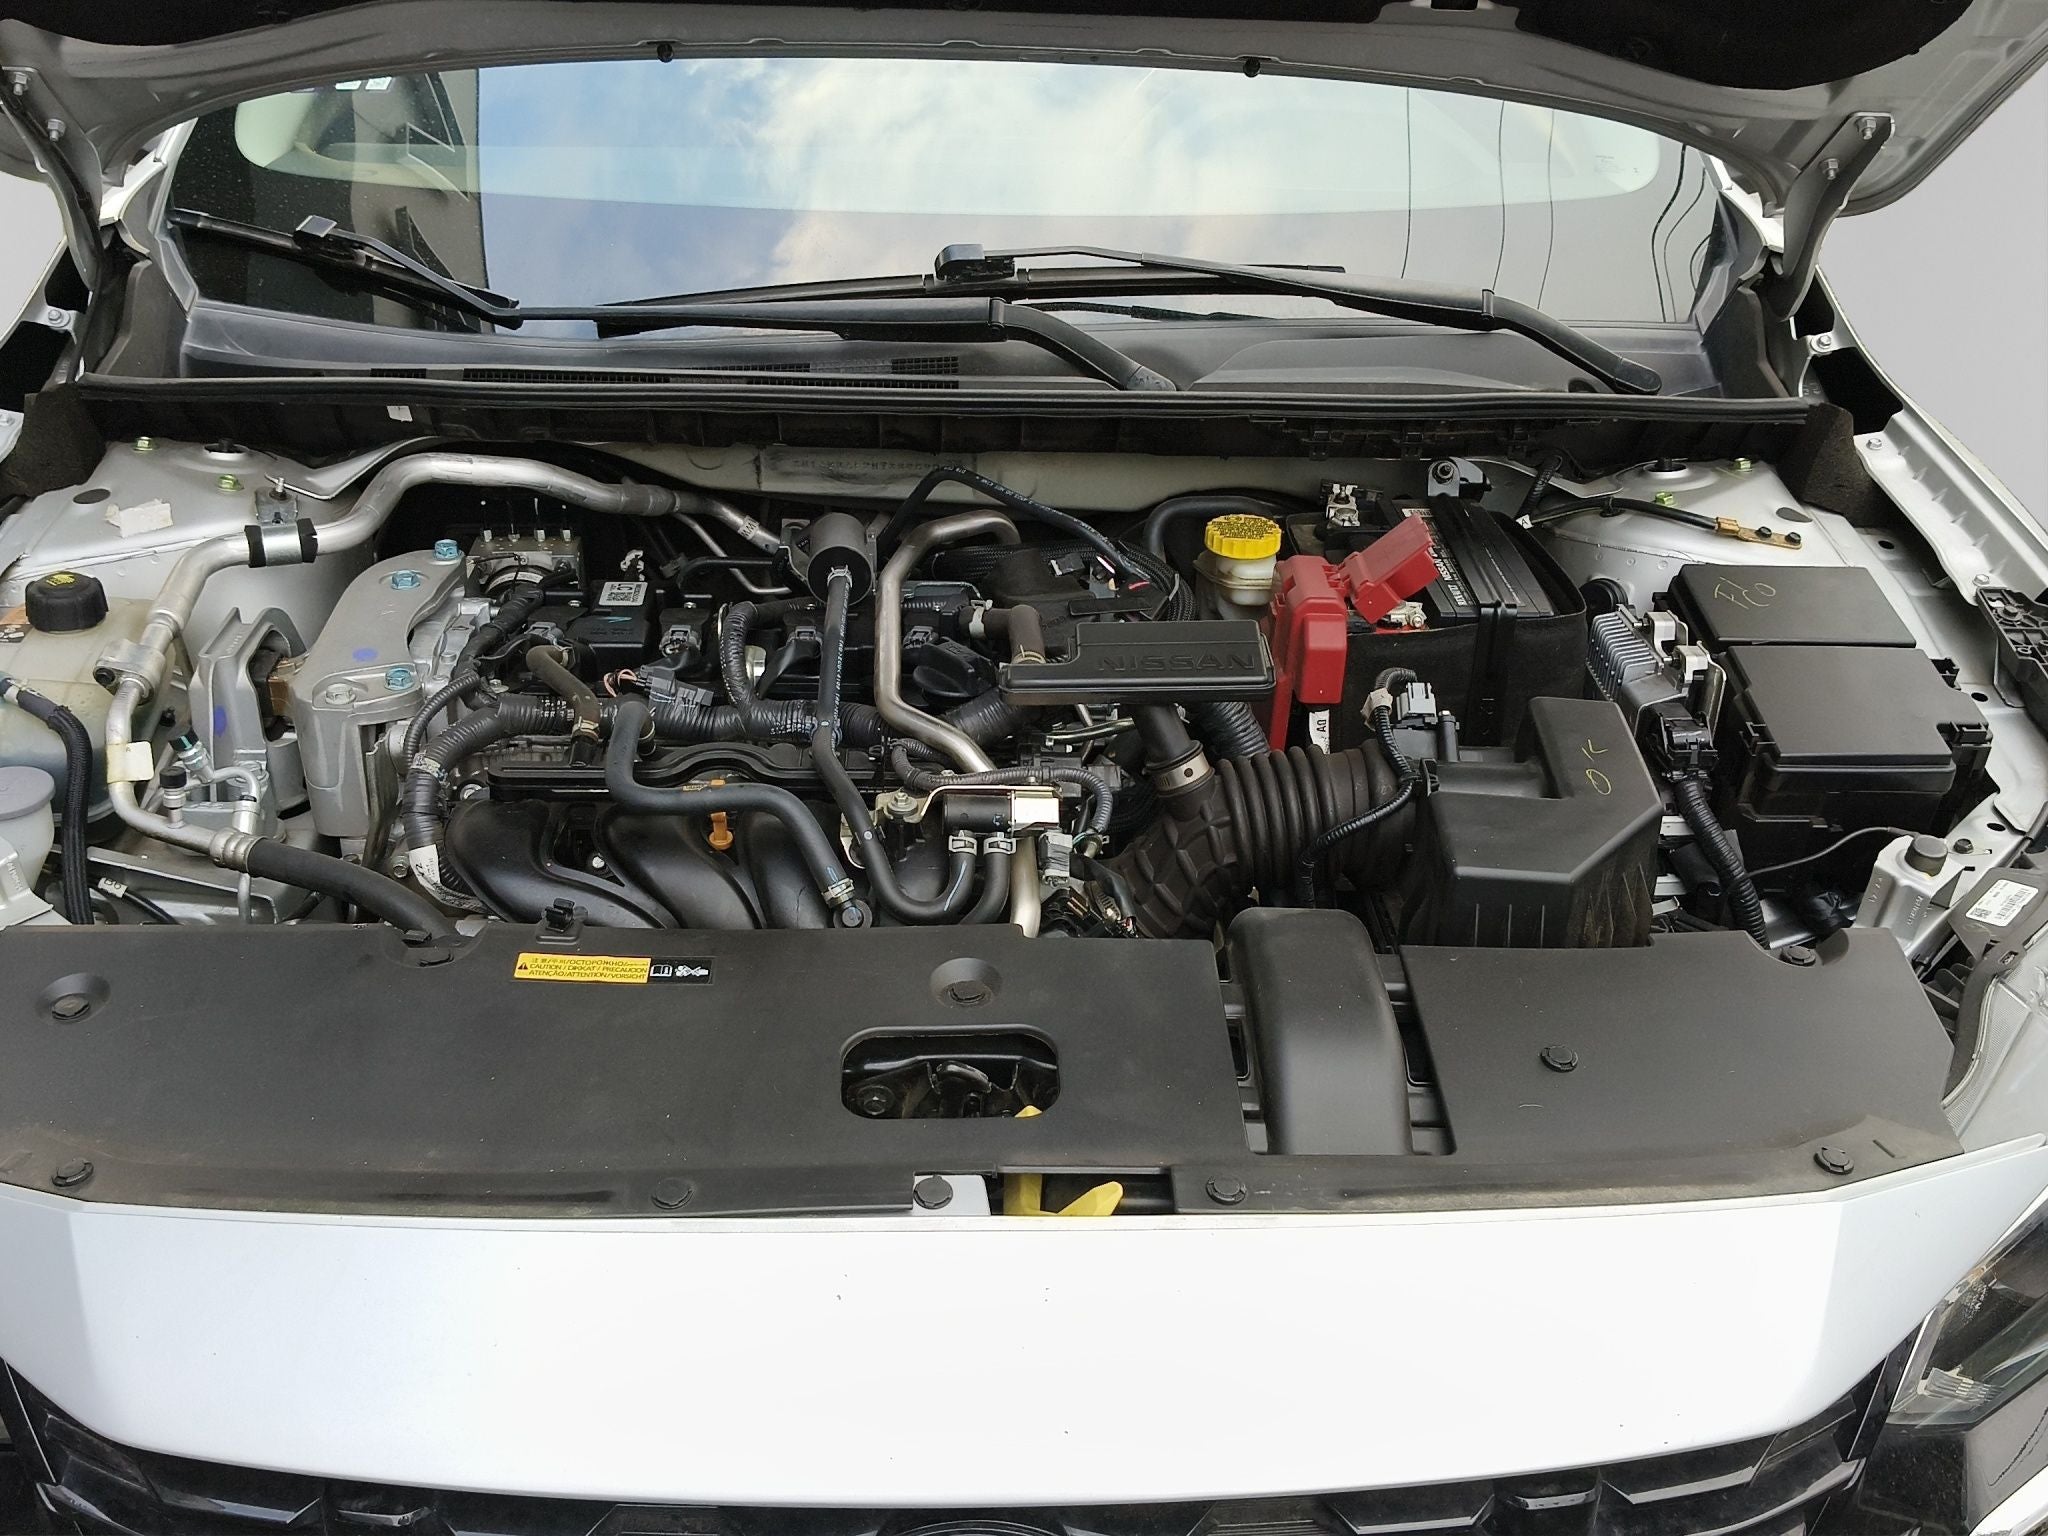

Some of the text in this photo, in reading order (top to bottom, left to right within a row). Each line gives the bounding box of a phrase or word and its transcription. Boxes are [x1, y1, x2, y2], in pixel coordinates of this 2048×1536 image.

[1434, 558, 1453, 580] NISSAN
[1098, 654, 1256, 671] NISSAN
[1581, 738, 1612, 796] OK
